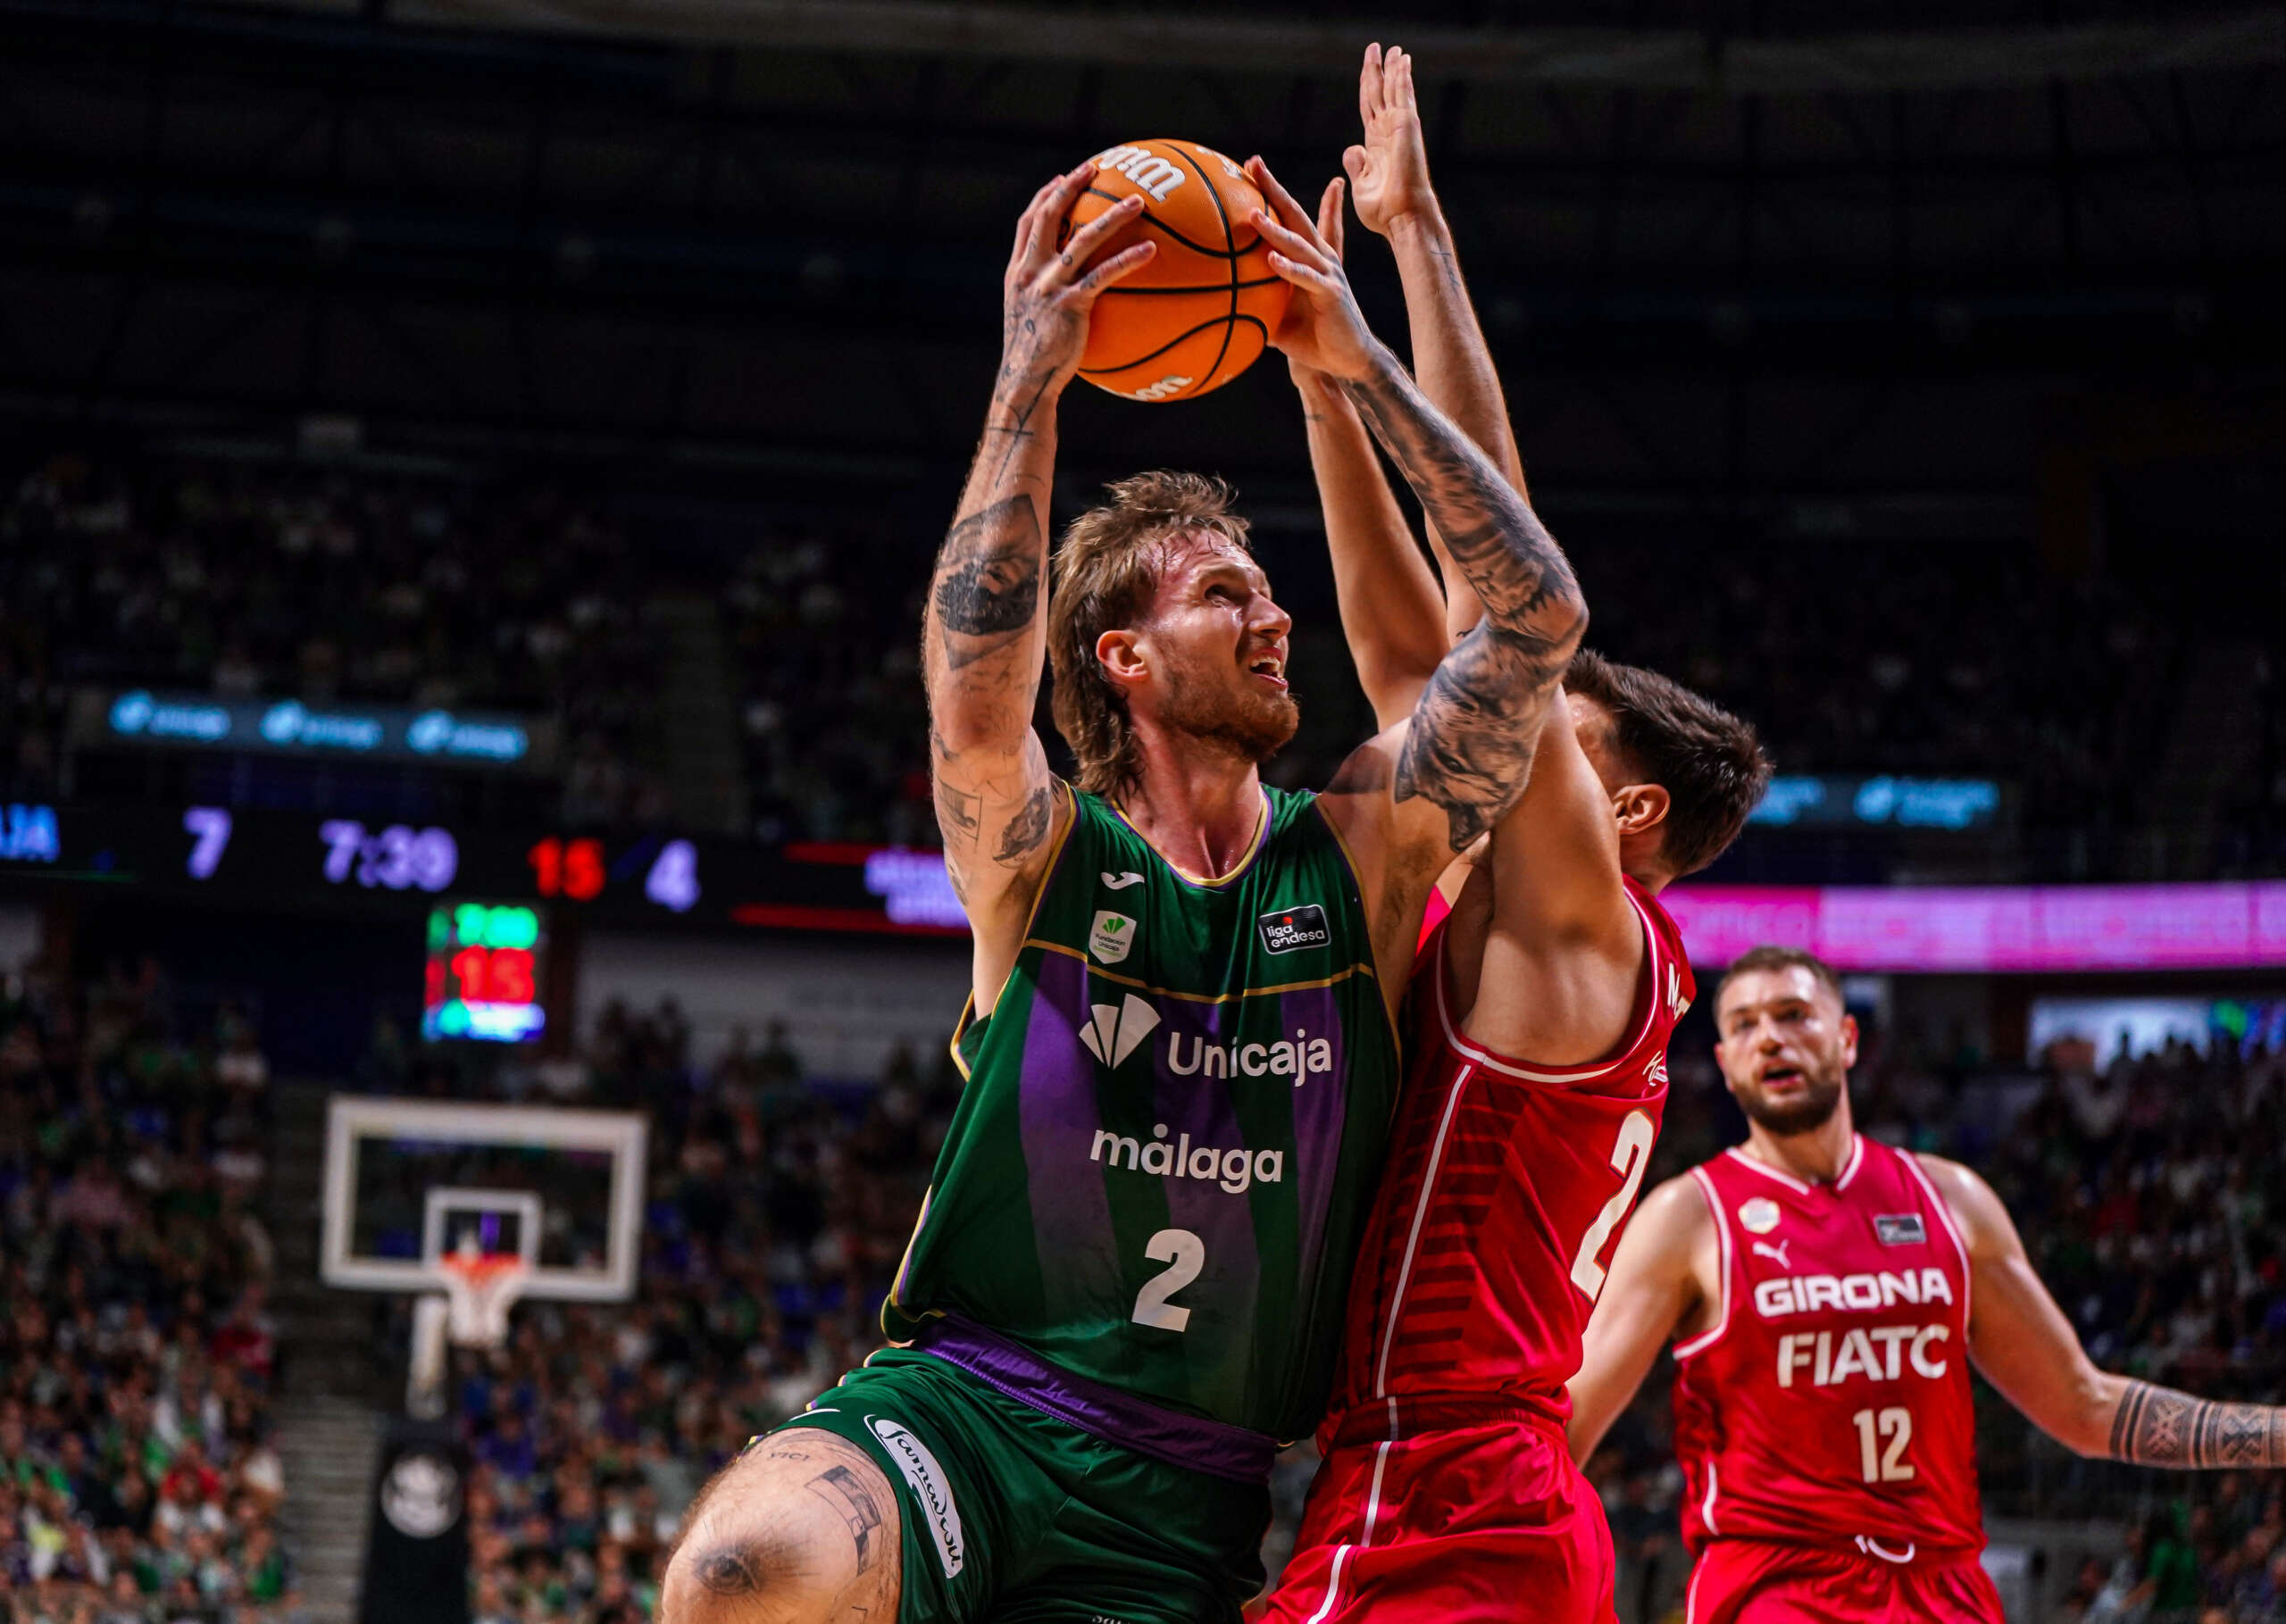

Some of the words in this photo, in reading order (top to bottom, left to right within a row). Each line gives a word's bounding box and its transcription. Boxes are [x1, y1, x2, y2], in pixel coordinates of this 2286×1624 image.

[184, 807, 231, 879] 7
[1266, 925, 1293, 937] liga
[1271, 929, 1325, 947] endesa
[1168, 1029, 1332, 1087] Unicaja
[1571, 1107, 1655, 1305] 2
[1131, 1228, 1206, 1332] 2
[1754, 1267, 1953, 1318] GIRONA
[1777, 1324, 1950, 1388] FIATC
[1853, 1407, 1915, 1484] 12
